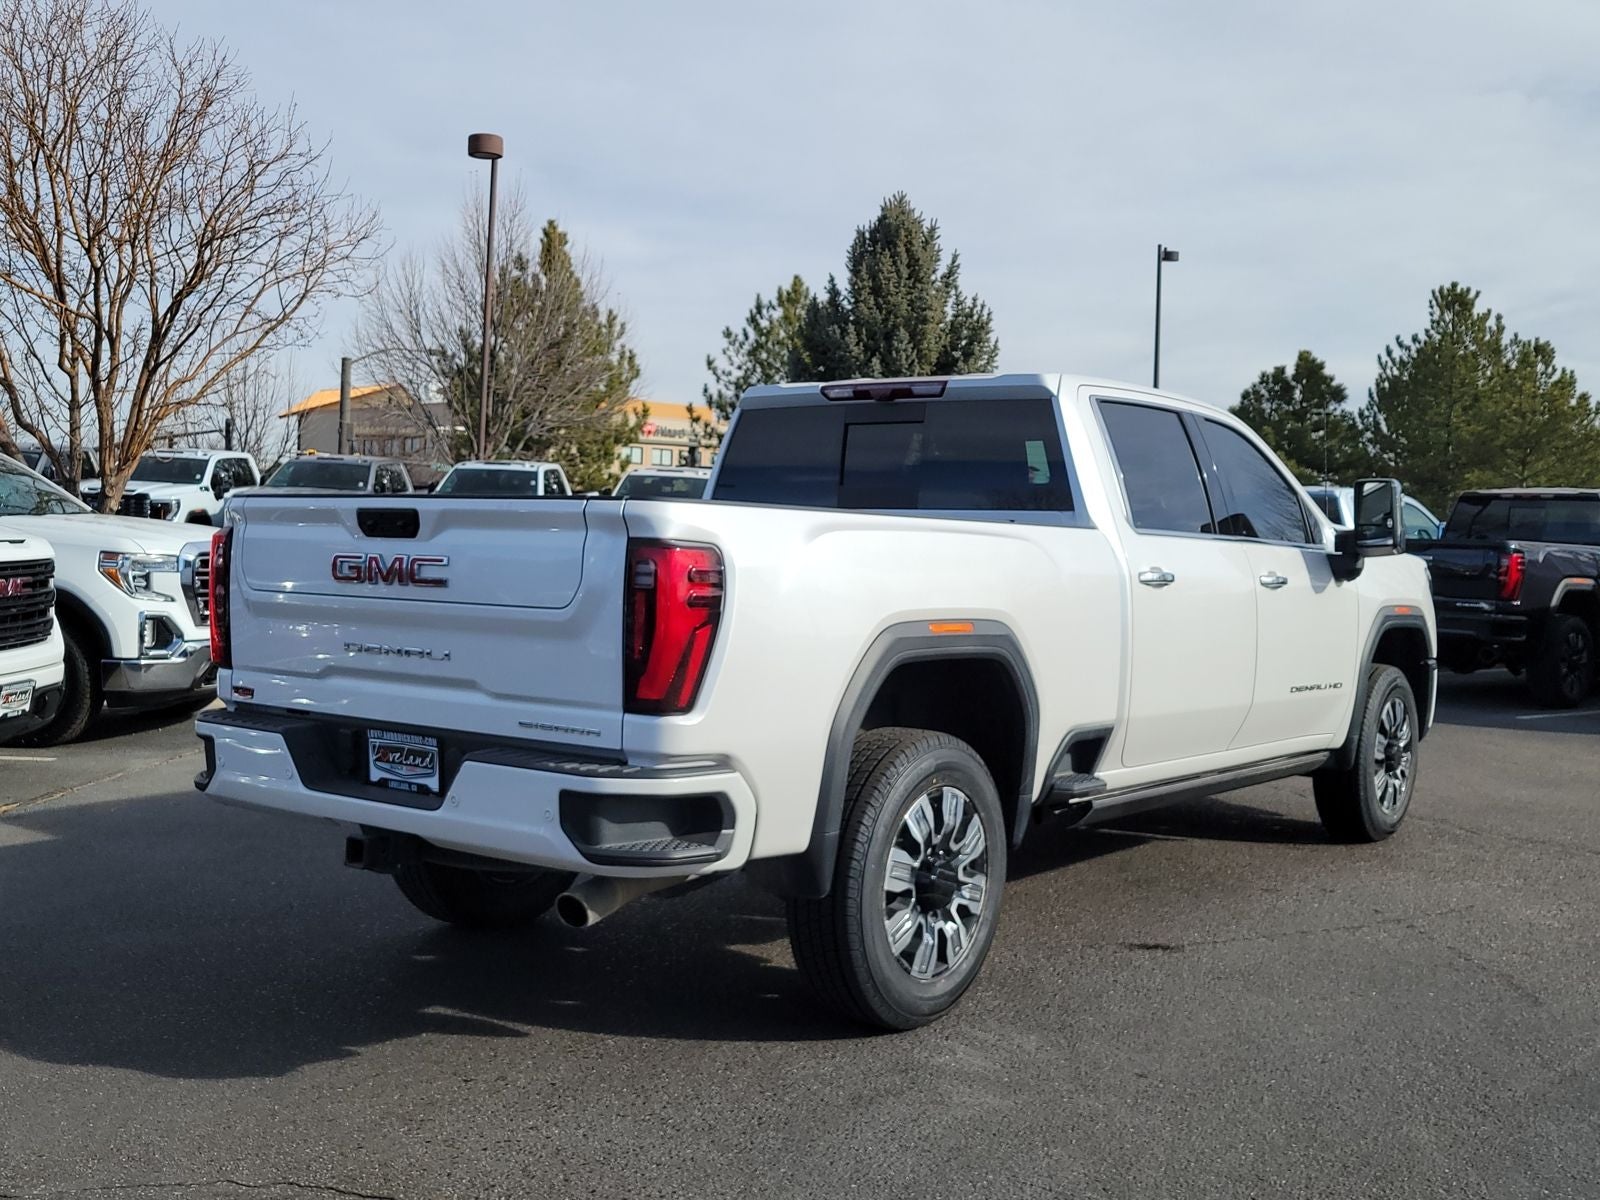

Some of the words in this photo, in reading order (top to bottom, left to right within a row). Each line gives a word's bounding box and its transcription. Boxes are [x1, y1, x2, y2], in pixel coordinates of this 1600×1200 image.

[331, 552, 449, 588] GMC
[0, 576, 33, 597] MC
[344, 641, 451, 661] DENALI
[1290, 683, 1328, 693] DENALI
[518, 720, 601, 737] SIERRA
[372, 741, 434, 768] Loveland
